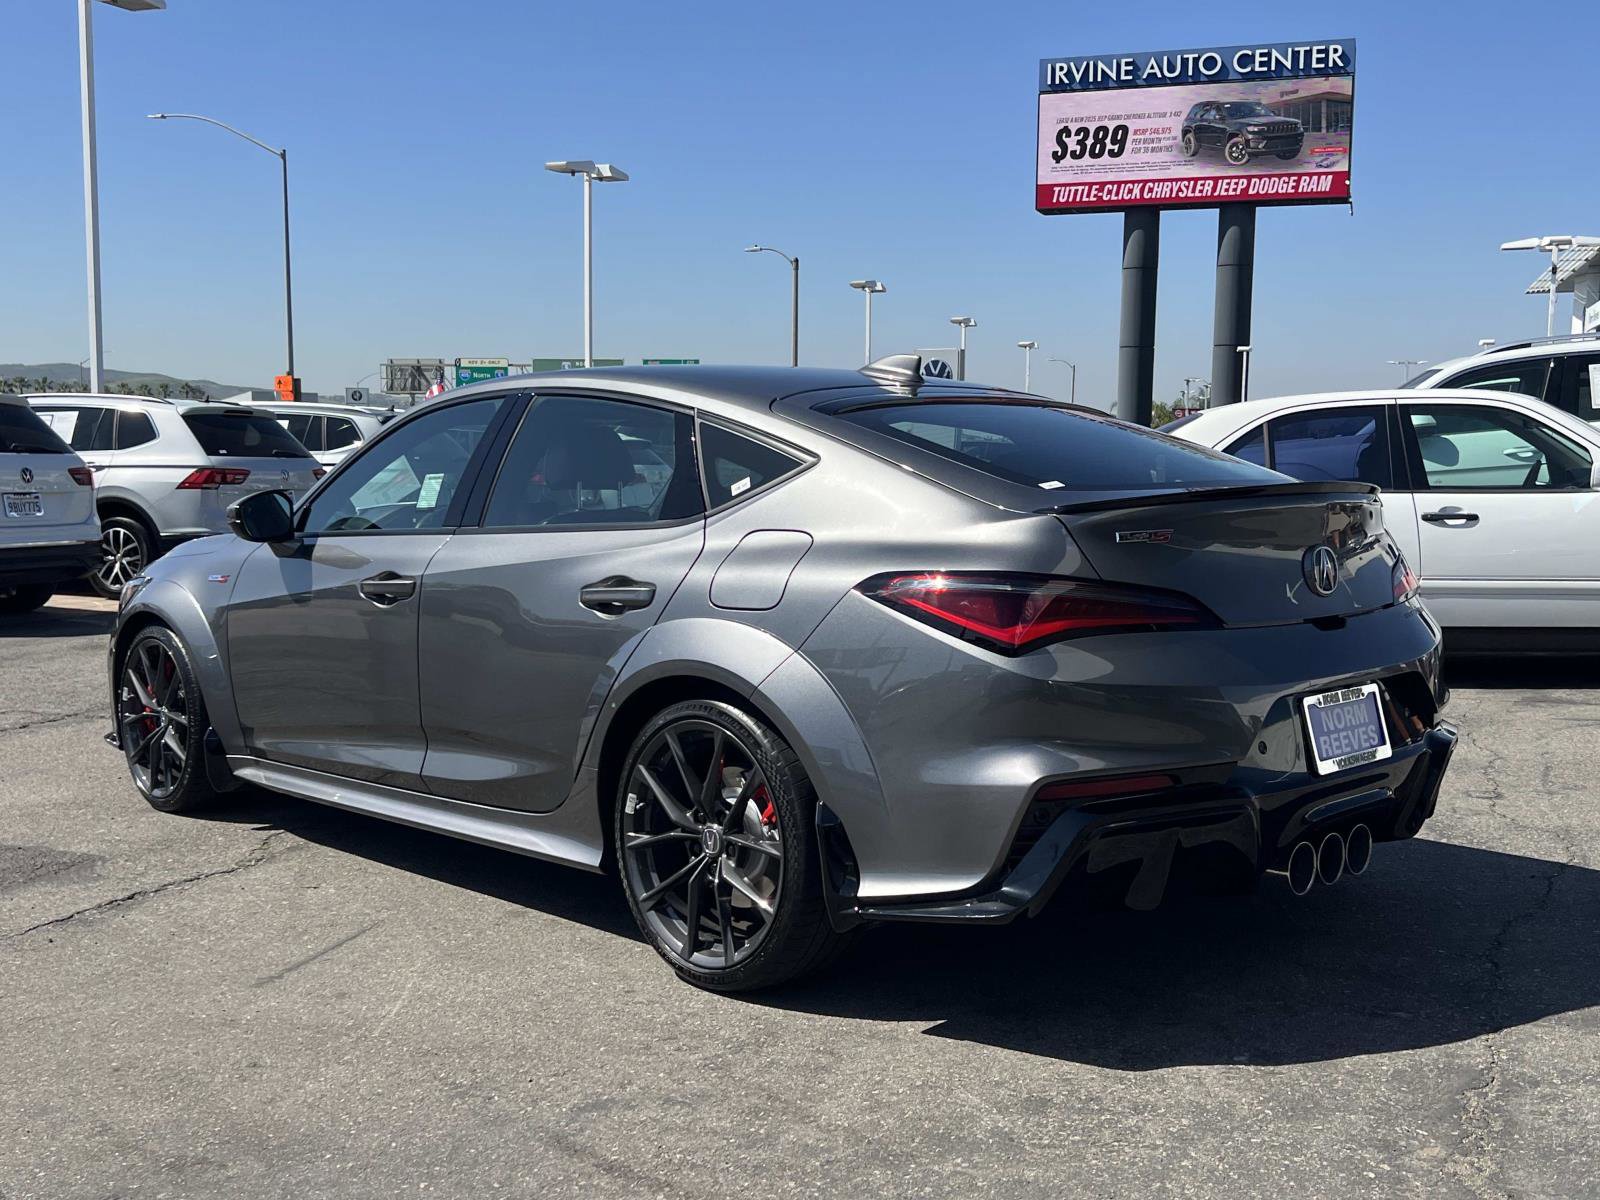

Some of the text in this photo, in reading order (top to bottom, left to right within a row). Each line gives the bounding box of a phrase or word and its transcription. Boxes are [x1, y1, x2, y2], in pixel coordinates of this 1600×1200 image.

[1046, 44, 1344, 85] IRVINE AUTO CENTER
[1051, 124, 1129, 164] $389
[1131, 137, 1141, 146] PER
[1142, 136, 1162, 145] MONTH
[1150, 144, 1173, 153] MONTHS
[1052, 174, 1333, 203] TUTTLE-CLICK CHRYSLER JEEP DODGE RAM
[1320, 703, 1369, 732] NORM
[1320, 725, 1379, 758] REEVES
